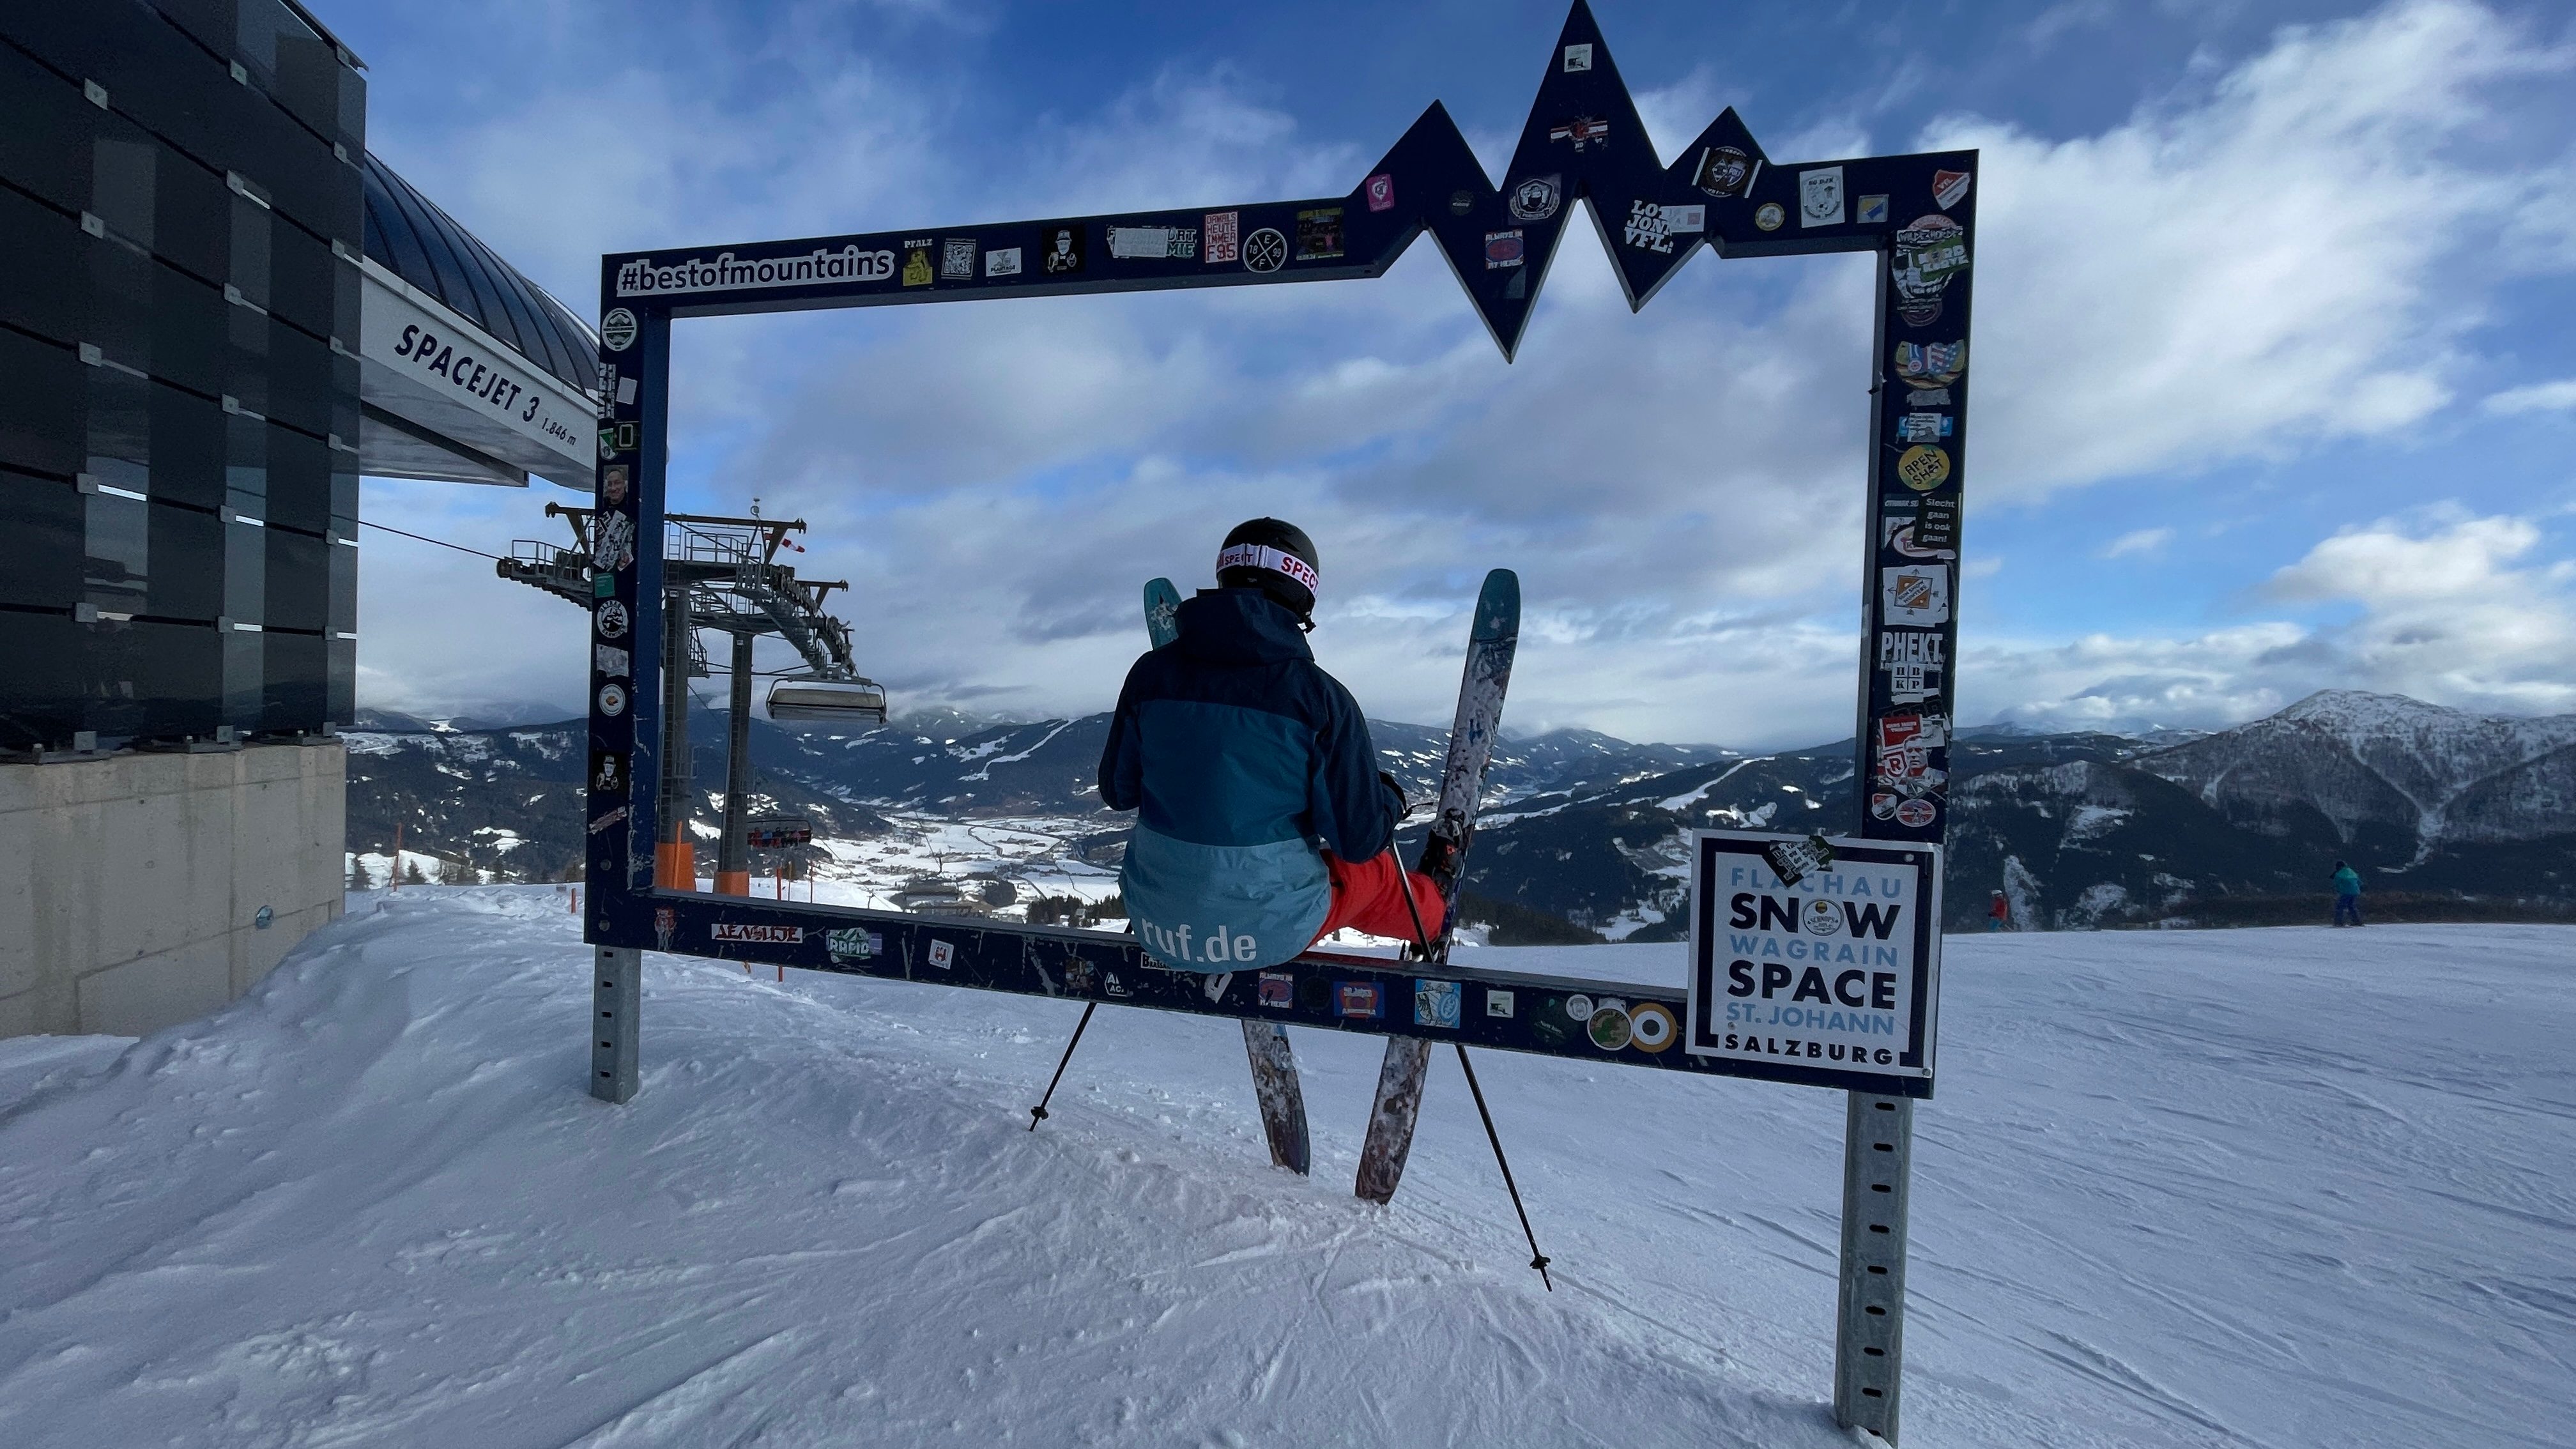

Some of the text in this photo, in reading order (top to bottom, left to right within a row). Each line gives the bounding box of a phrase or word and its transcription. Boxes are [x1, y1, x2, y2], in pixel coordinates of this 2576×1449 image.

[1207, 213, 1236, 224] DAMALS
[1631, 200, 1668, 221] LO
[1207, 222, 1236, 234] HEUTE
[1207, 233, 1236, 244] IMMER
[1264, 234, 1271, 244] E
[904, 239, 933, 249] PFALZ
[1249, 245, 1258, 254] 18
[1625, 226, 1674, 254] VFL!
[1207, 243, 1235, 261] F95
[1259, 258, 1266, 268] F
[1272, 248, 1282, 257] 99
[1919, 245, 1964, 264] NRD
[620, 249, 891, 292] #bestofmountains
[394, 325, 540, 422] SPACEJET 3
[541, 417, 576, 447] 1.846 m
[1905, 450, 1938, 475] APEN
[1926, 498, 1955, 509] Slecht
[1881, 632, 1943, 663] PHEKT
[1729, 893, 1901, 940] SNW
[1141, 917, 1257, 963] ruf.de
[1729, 933, 1897, 967] WAGRAIN
[1727, 960, 1896, 1009] SPACE
[1726, 1001, 1894, 1035] ST. JOHANN
[1725, 1034, 1892, 1064] SALZBURG
